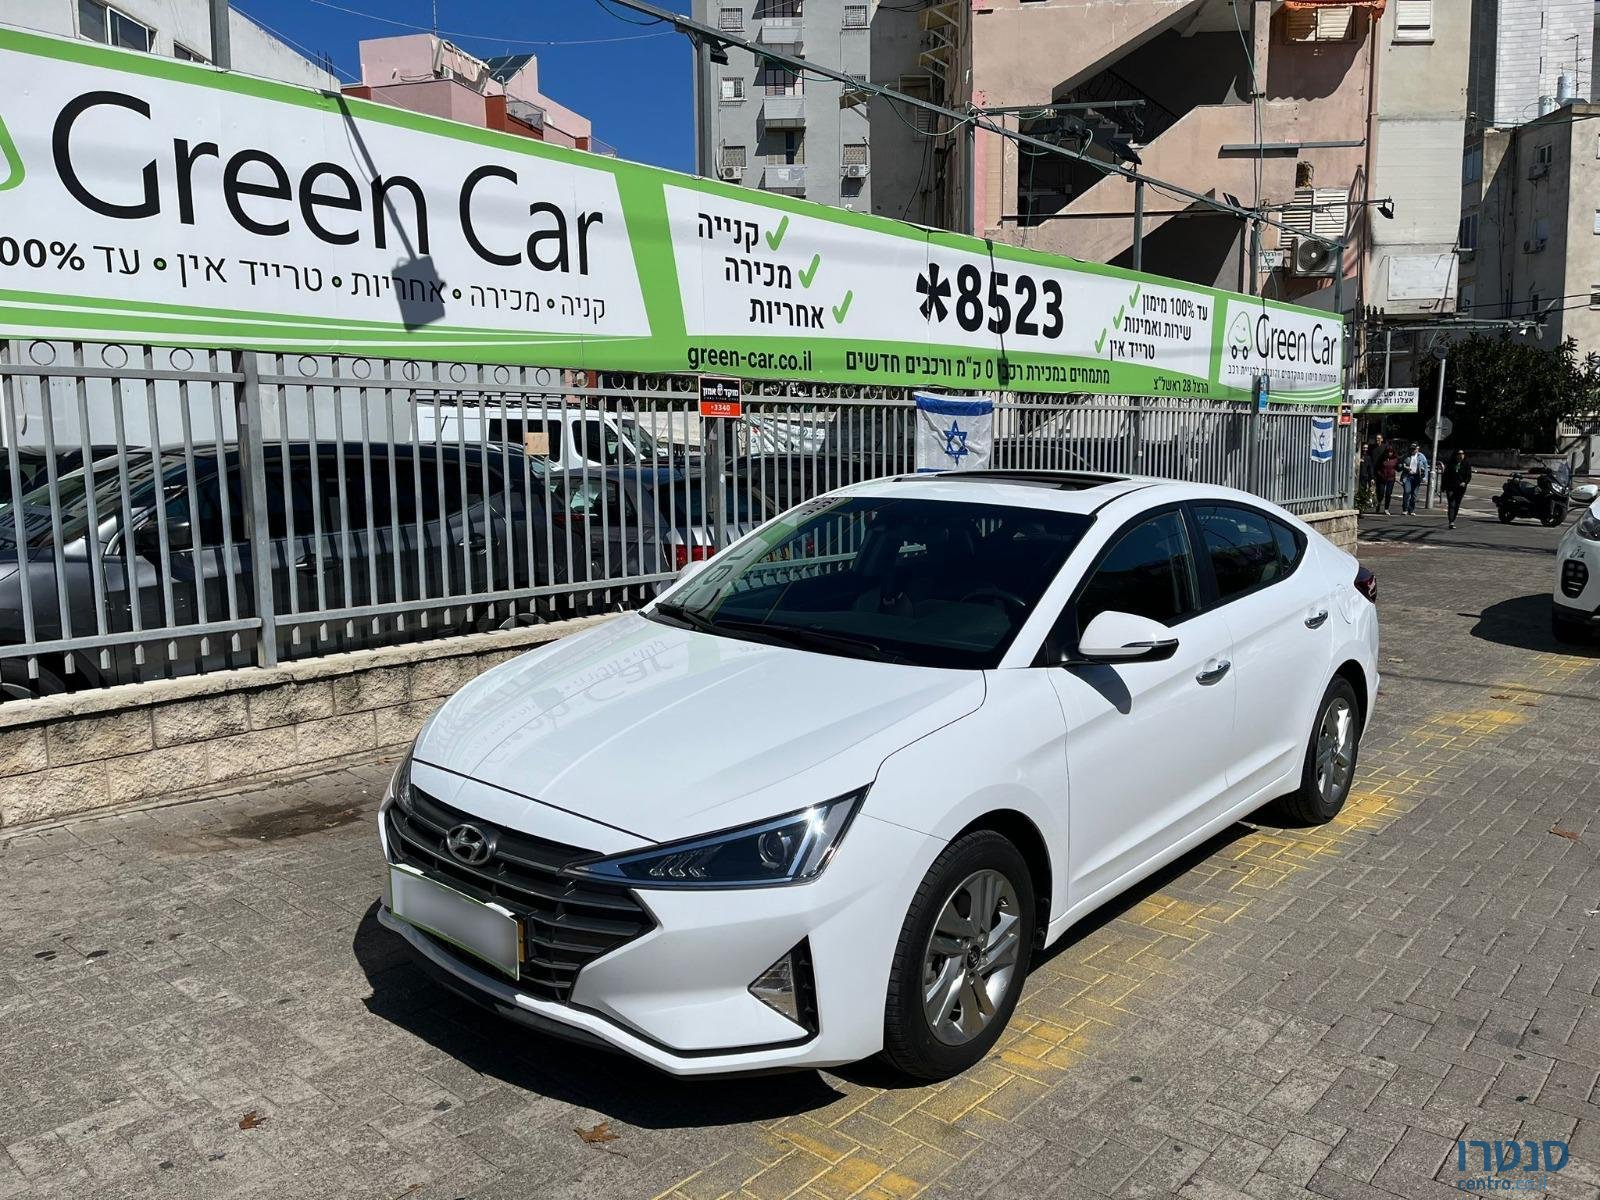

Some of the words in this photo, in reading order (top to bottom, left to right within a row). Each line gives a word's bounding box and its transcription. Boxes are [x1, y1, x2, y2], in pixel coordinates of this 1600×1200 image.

[52, 90, 430, 255] Green
[458, 164, 604, 276] Car
[698, 212, 759, 253] קנייה
[93, 244, 141, 275] עד
[177, 253, 227, 288] אין
[239, 259, 323, 291] טרייד
[725, 256, 792, 289] מכירה
[351, 272, 446, 303] אחריות
[470, 285, 539, 312] מכירה
[561, 295, 605, 324] קניה
[750, 298, 825, 330] אחריות
[1142, 293, 1167, 315] מימון
[1169, 297, 1194, 319] 100%
[1196, 304, 1208, 321] עד
[1124, 316, 1162, 337] ואמינות
[1163, 322, 1191, 341] שירות
[1109, 339, 1125, 361] אין
[1128, 341, 1155, 360] טרייד
[1256, 313, 1307, 363] Green
[1311, 323, 1337, 366] Car
[687, 346, 812, 372] green-car.co.il
[846, 350, 900, 373] חדשים
[905, 356, 951, 376] ורכבים
[985, 358, 993, 379] 0
[1026, 364, 1067, 382] במכירת
[1070, 367, 1110, 384] מתמחים
[1182, 379, 1191, 393] 28
[1192, 379, 1209, 394] הרצל
